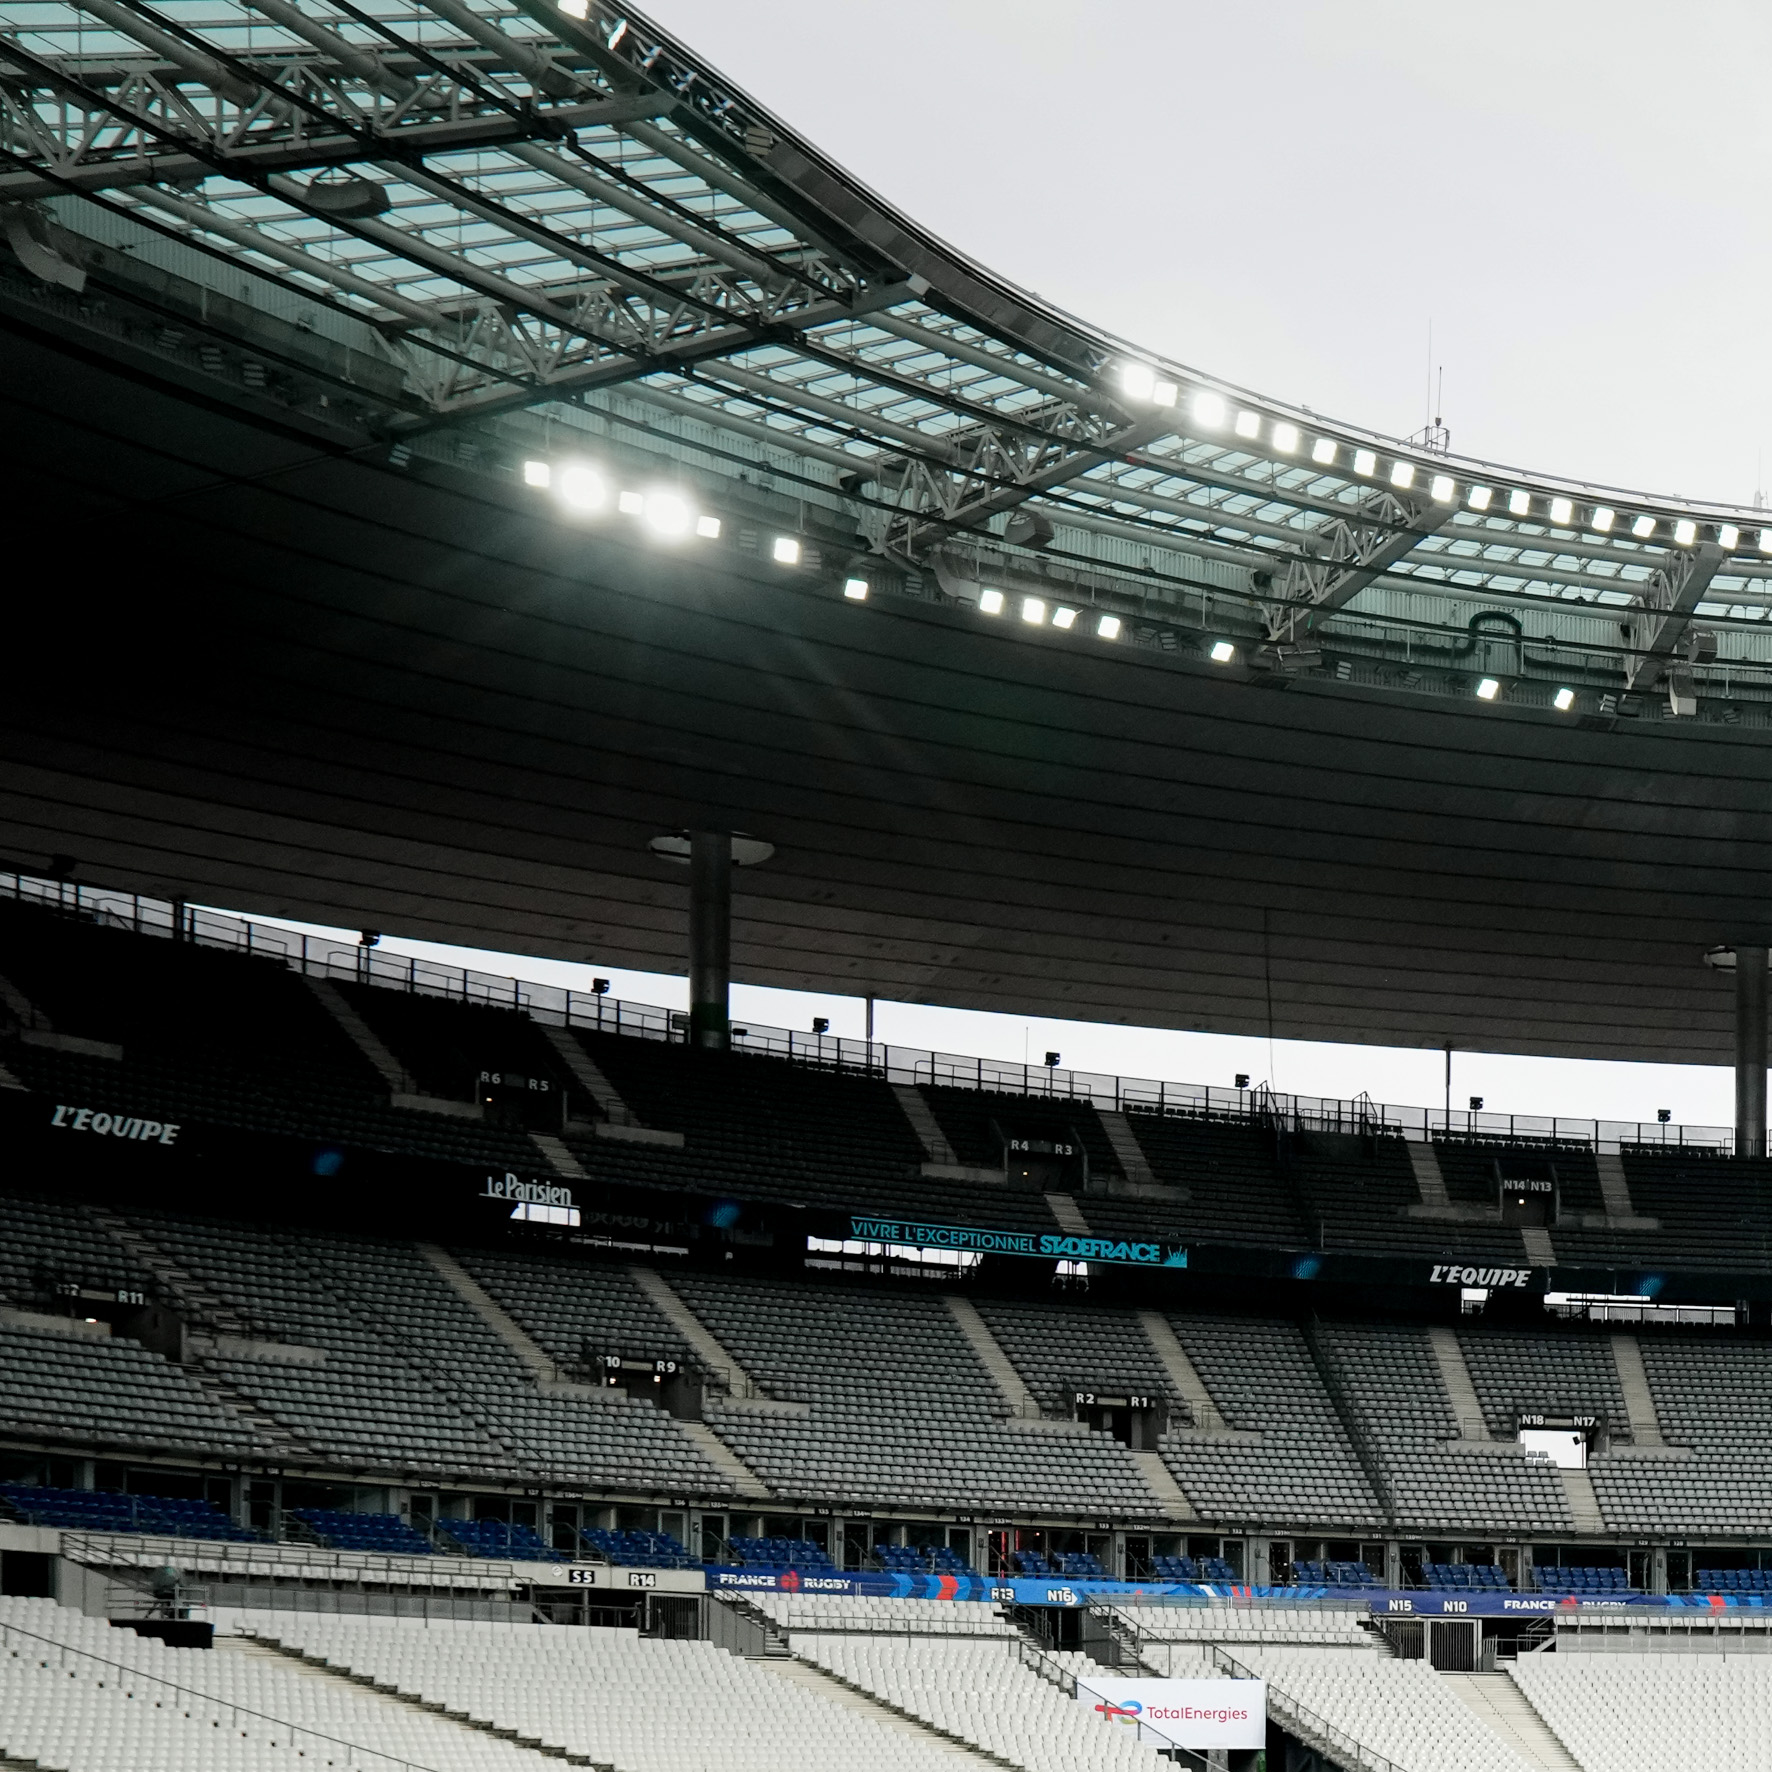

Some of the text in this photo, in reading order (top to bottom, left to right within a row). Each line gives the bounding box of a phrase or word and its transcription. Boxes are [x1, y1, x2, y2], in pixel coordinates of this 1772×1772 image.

[486, 1173, 573, 1204] Le Parisien
[851, 1220, 900, 1239] VIVRE
[905, 1225, 1036, 1253] L'EXCEPTIONNEL
[720, 1574, 851, 1591] FRANCE RUGBY
[1147, 1707, 1247, 1722] TotalEnergies
